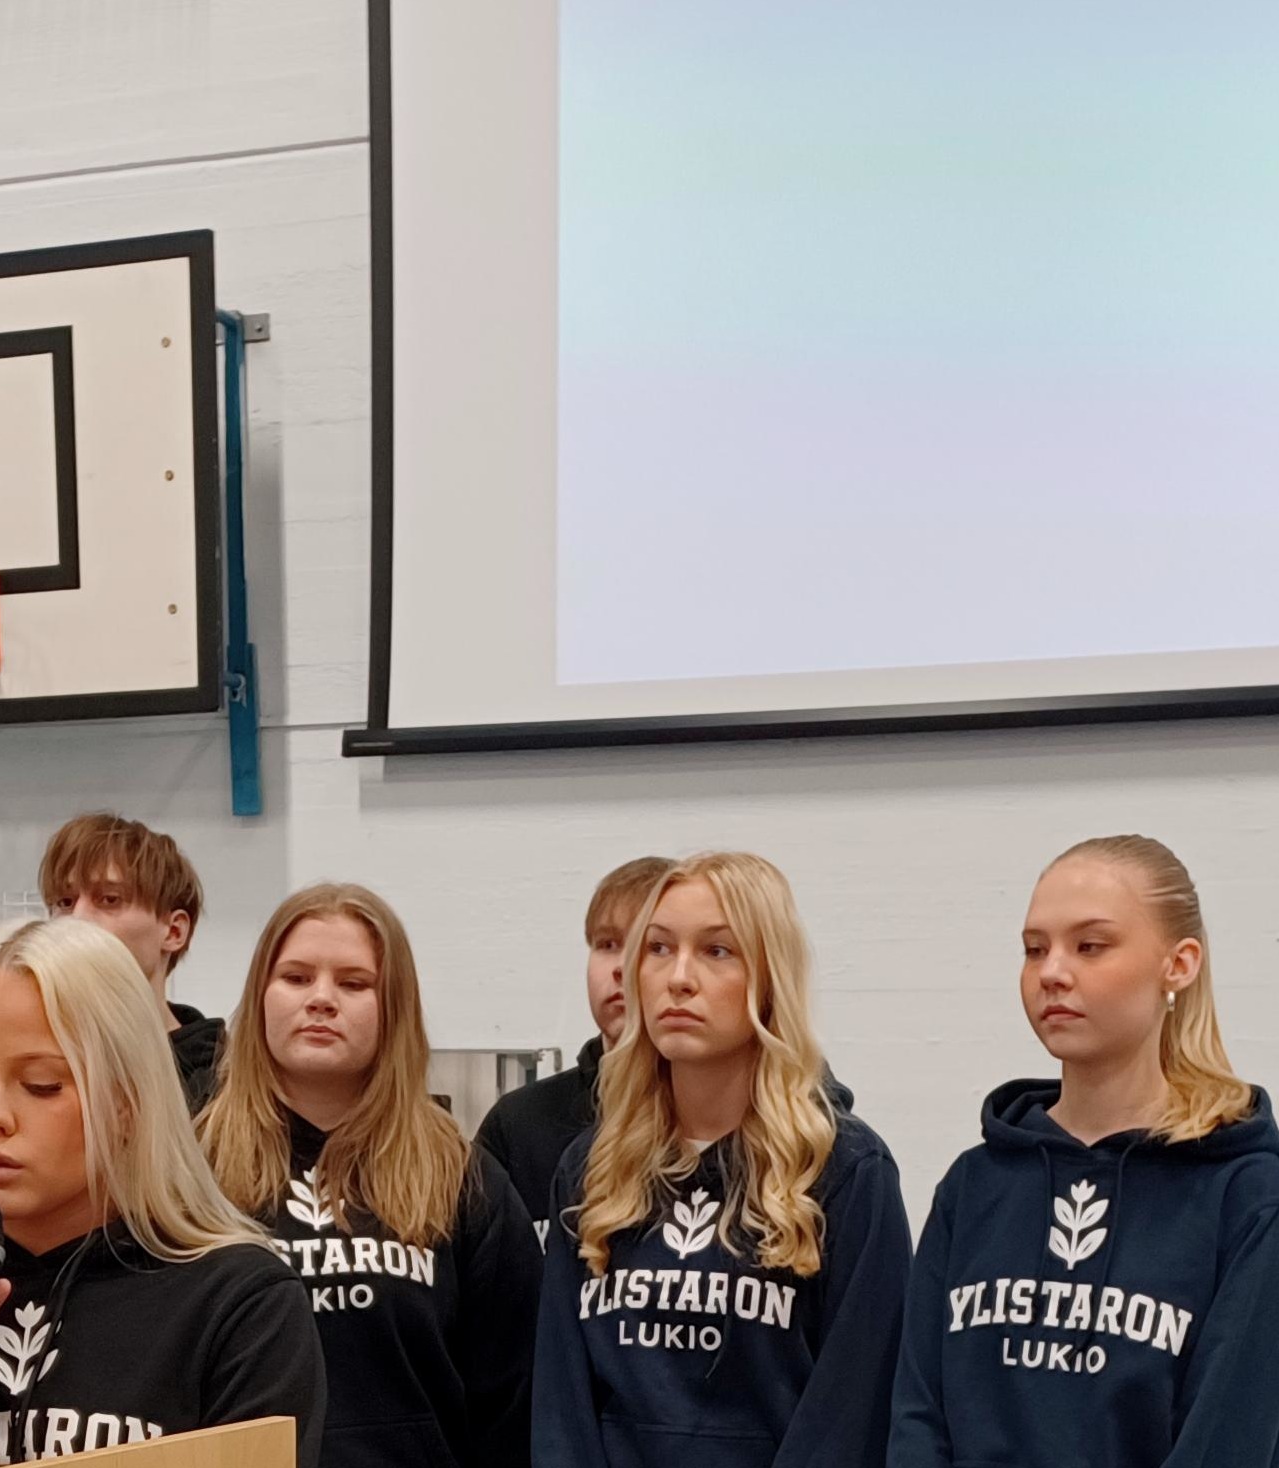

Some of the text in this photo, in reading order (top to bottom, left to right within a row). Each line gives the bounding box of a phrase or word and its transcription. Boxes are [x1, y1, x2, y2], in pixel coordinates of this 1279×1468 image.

[270, 1236, 435, 1288] STARON
[311, 1283, 374, 1313] KIO
[578, 1268, 797, 1330] YLISTARON
[948, 1277, 1193, 1358] YLISTARON
[619, 1320, 722, 1351] LUKIO
[1002, 1337, 1107, 1374] LUKIO
